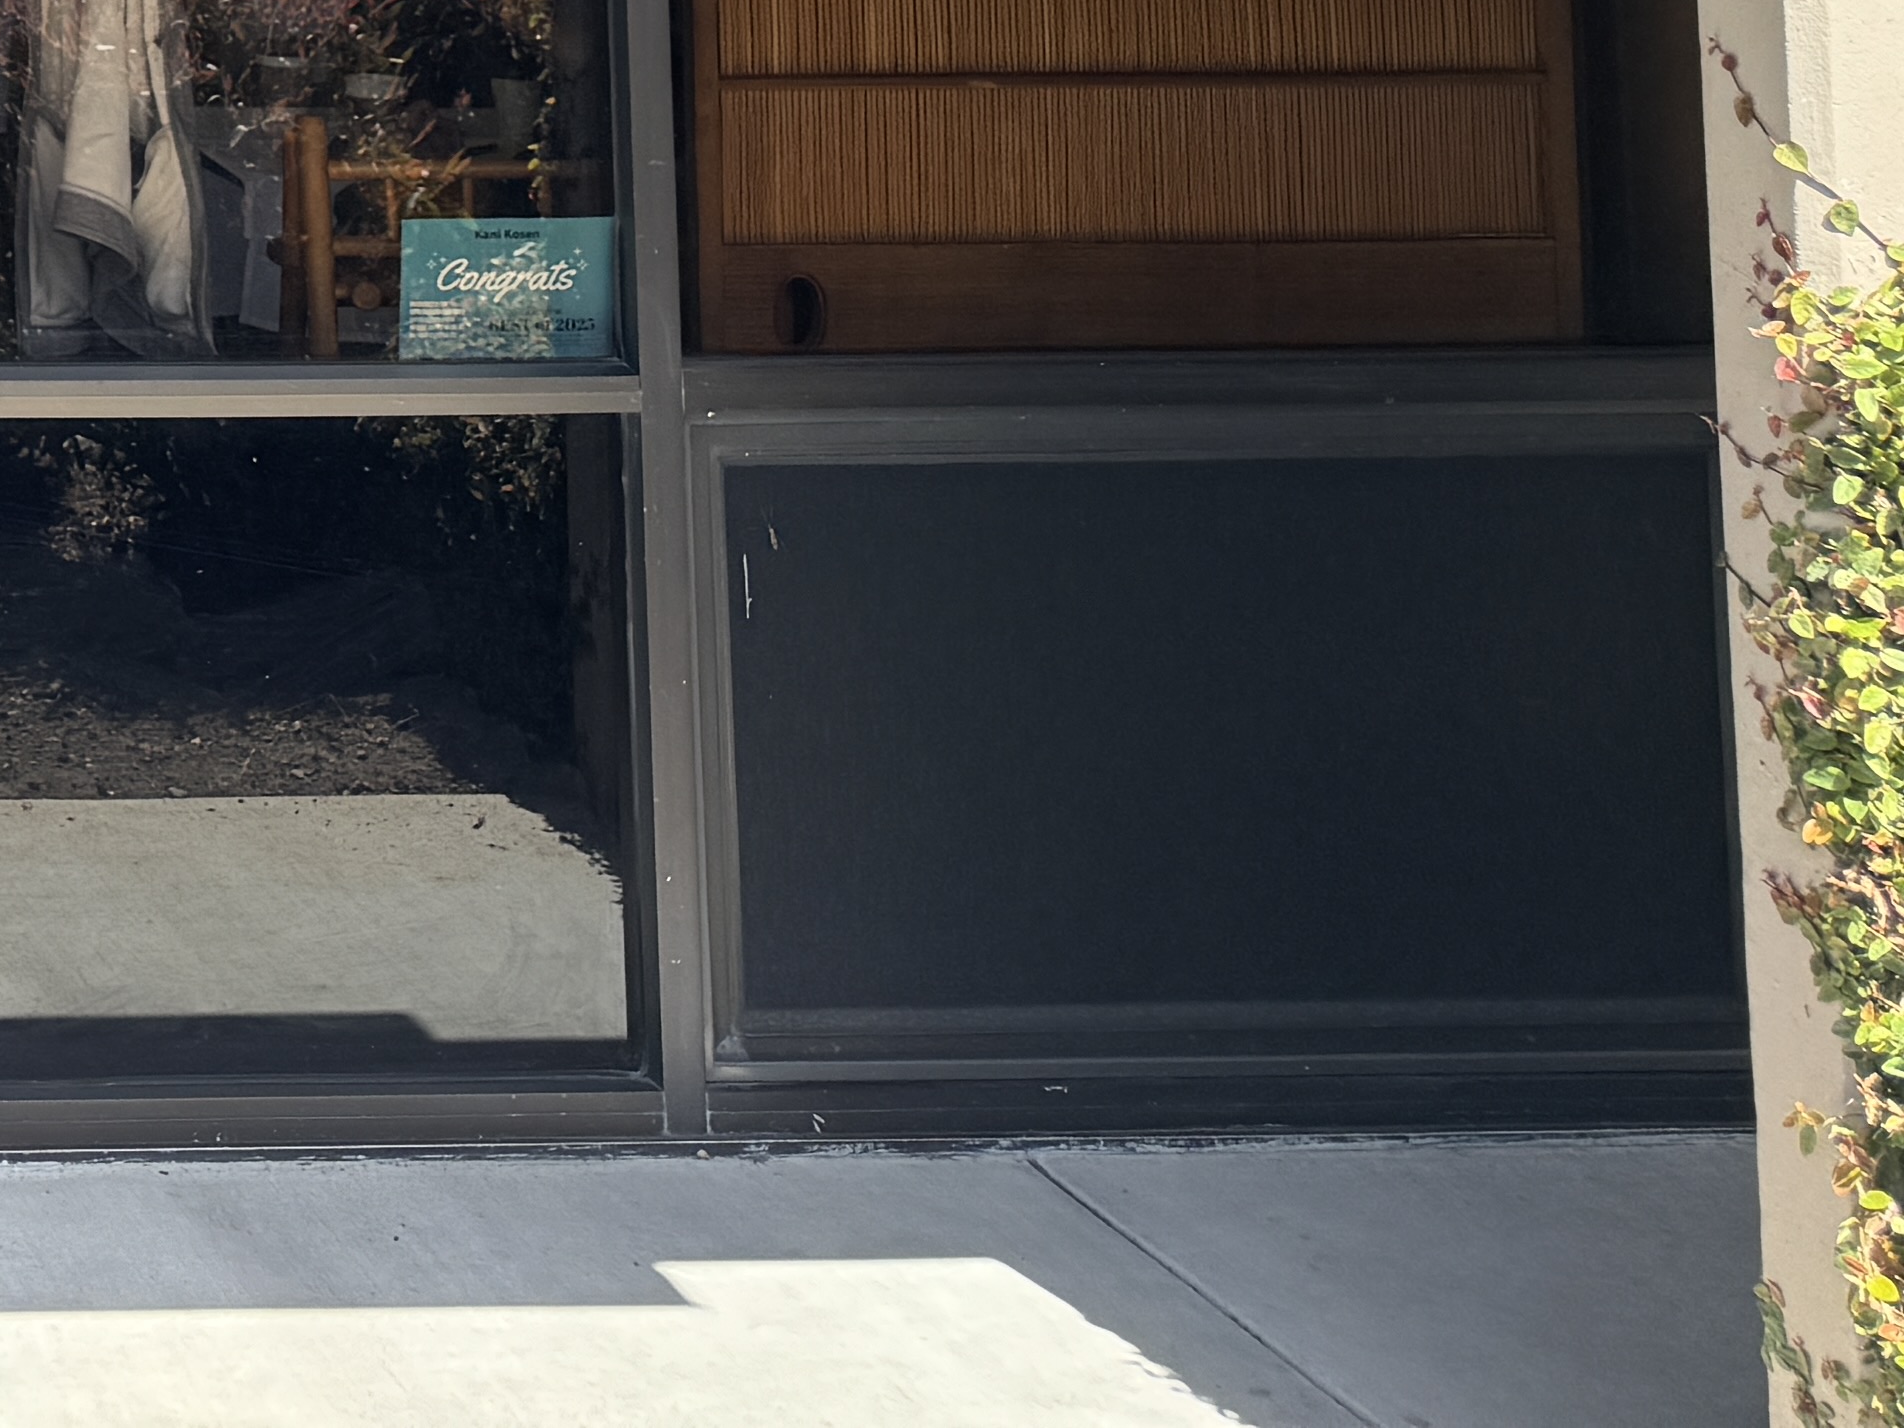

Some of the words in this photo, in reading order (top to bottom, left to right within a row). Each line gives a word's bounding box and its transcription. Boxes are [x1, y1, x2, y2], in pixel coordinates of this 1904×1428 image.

[474, 228, 502, 239] Kani
[504, 228, 540, 239] Kosen
[437, 257, 578, 304] Congrats
